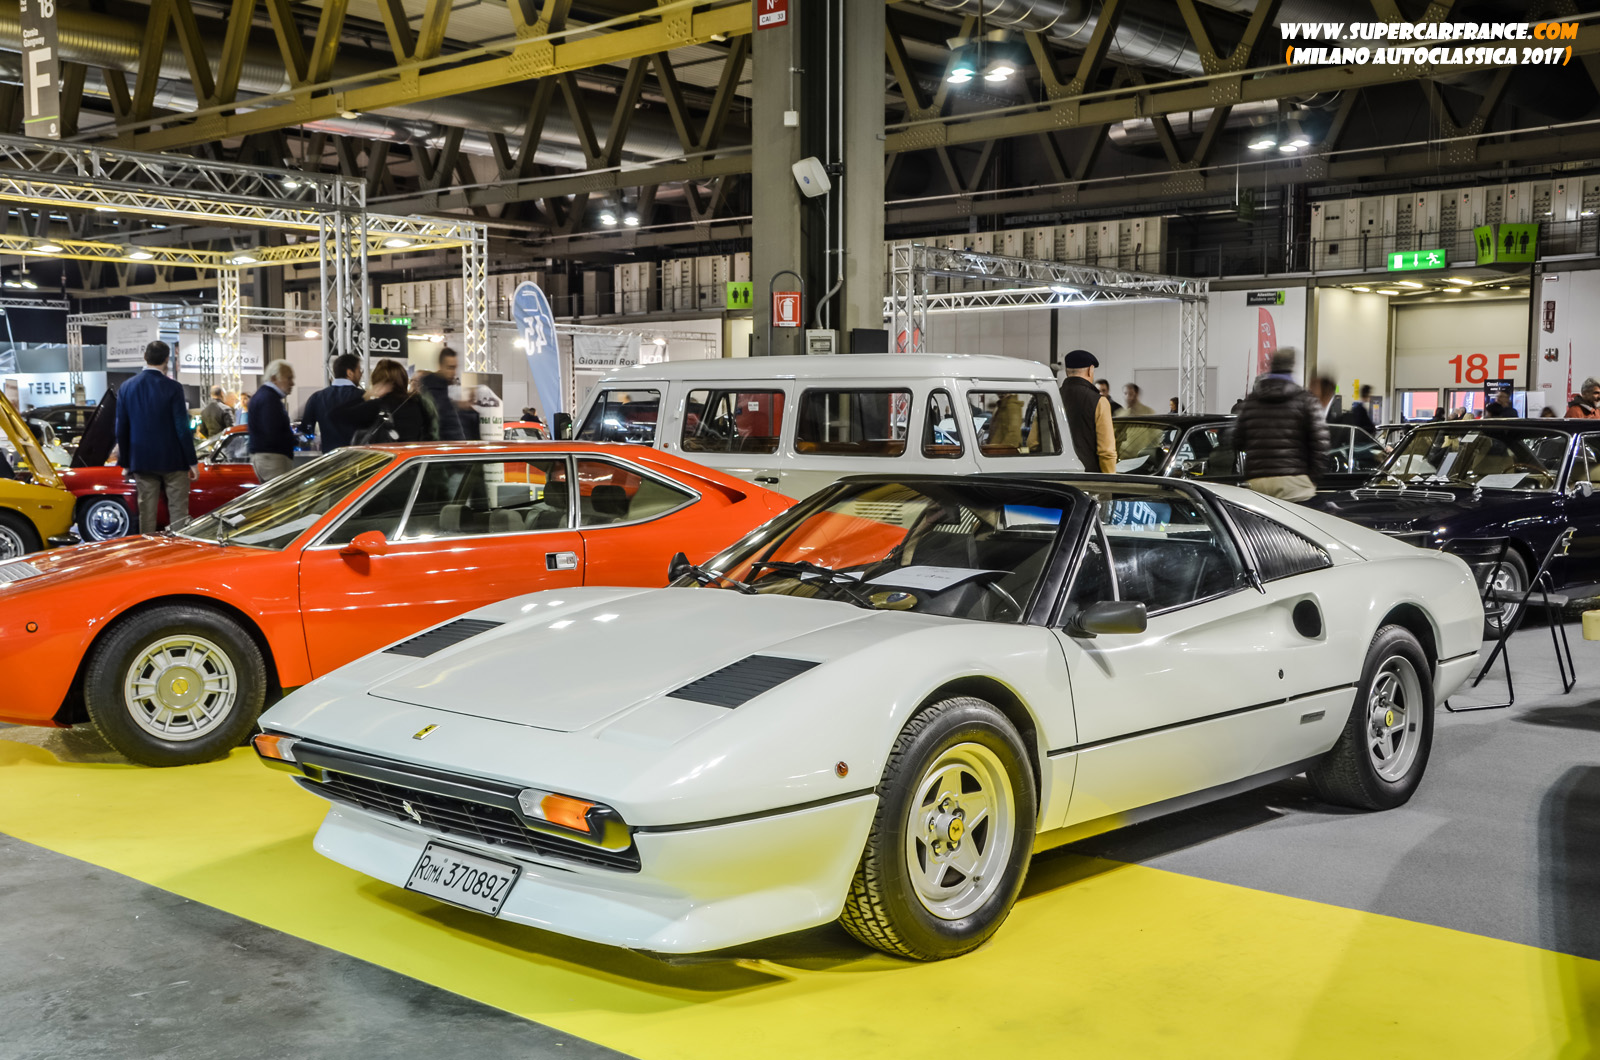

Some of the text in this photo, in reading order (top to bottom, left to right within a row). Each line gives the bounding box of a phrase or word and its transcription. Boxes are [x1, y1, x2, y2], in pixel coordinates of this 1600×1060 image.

[28, 47, 52, 116] F
[578, 356, 617, 365] Giovanni
[1448, 353, 1520, 384] 18 F
[28, 382, 67, 394] TESLA
[443, 862, 510, 903] 37089Z
